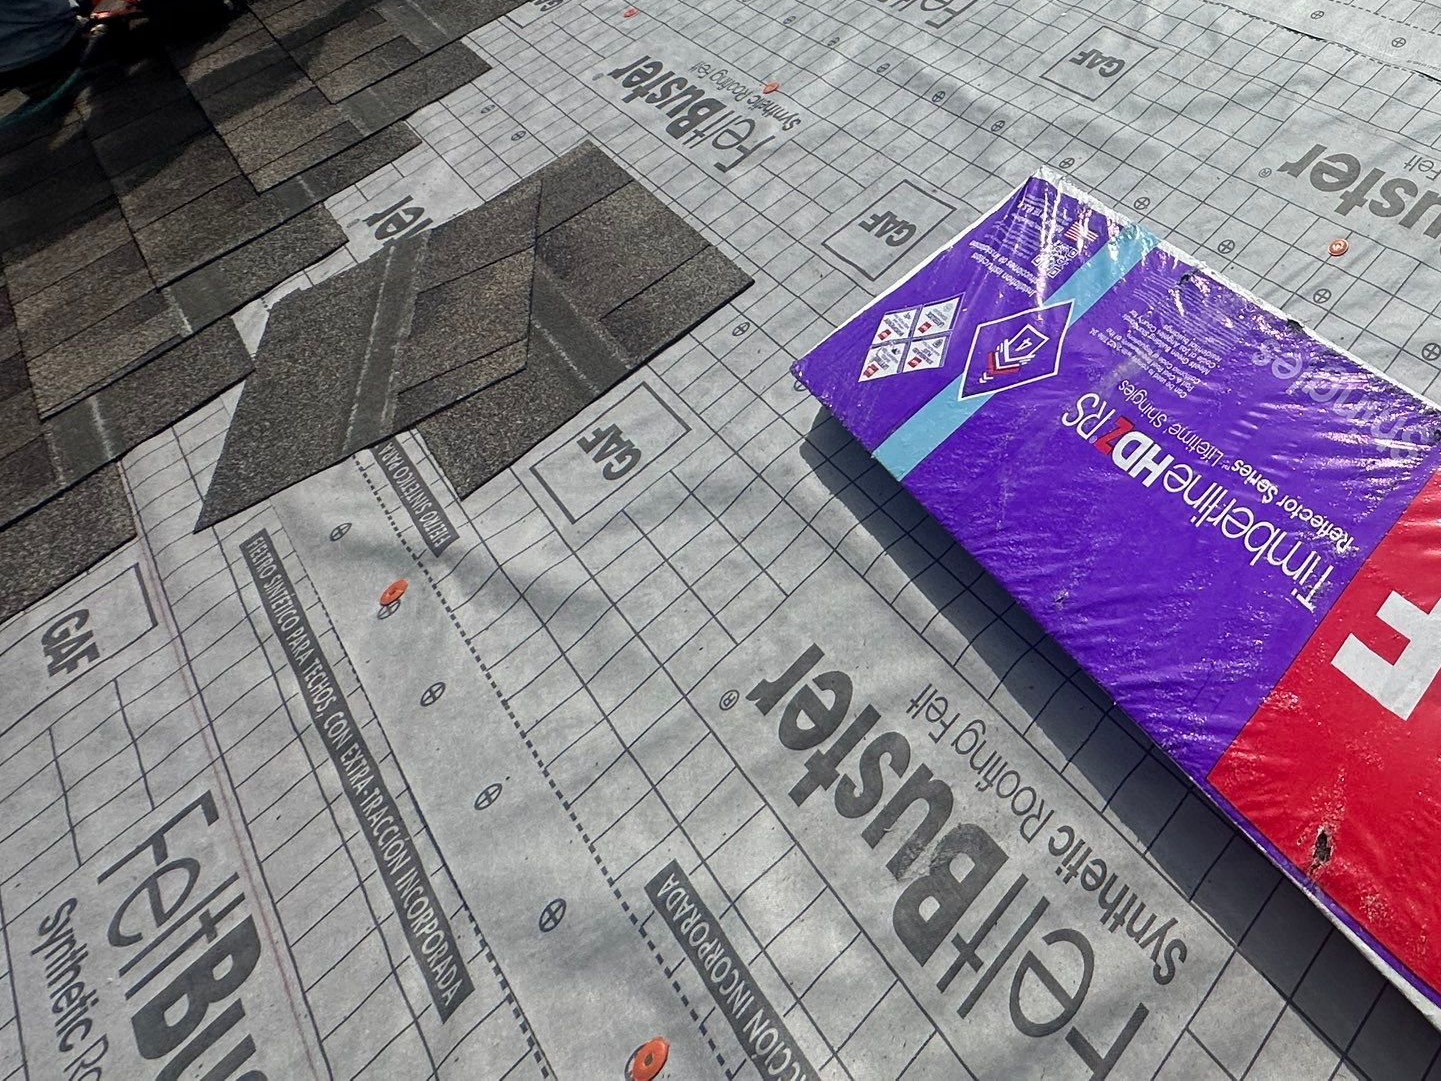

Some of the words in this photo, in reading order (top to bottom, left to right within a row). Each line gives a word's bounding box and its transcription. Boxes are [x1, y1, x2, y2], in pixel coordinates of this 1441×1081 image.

[1069, 49, 1126, 78] GAF
[608, 55, 775, 174] FeltBuster
[745, 93, 801, 130] Synthetic
[858, 210, 918, 248] GAF
[1001, 270, 1036, 298] Installation
[1170, 347, 1190, 364] Green
[1188, 358, 1210, 376] Meets
[1112, 376, 1173, 429] Shingles
[376, 441, 404, 471] PARA
[577, 423, 642, 481] GAF
[387, 464, 432, 516] SINTÉTICO
[417, 508, 453, 547] FIELTRO
[1273, 488, 1354, 554] Reflector
[243, 536, 279, 579] FIELTRO
[258, 572, 305, 632] SINTÉTICO
[41, 607, 100, 677] GAF
[282, 626, 317, 665] PARA
[294, 657, 341, 718] TECHOS,
[906, 683, 953, 744] Felt
[320, 710, 355, 750] CON
[952, 719, 1054, 844] Roofing
[334, 743, 418, 876] EXTRA-TRACCIÓN
[1049, 826, 1187, 986] Synthetic
[387, 870, 473, 1007] INCORPORADA
[656, 871, 754, 1019] INCORPORADA
[36, 897, 99, 1052] Synthetic
